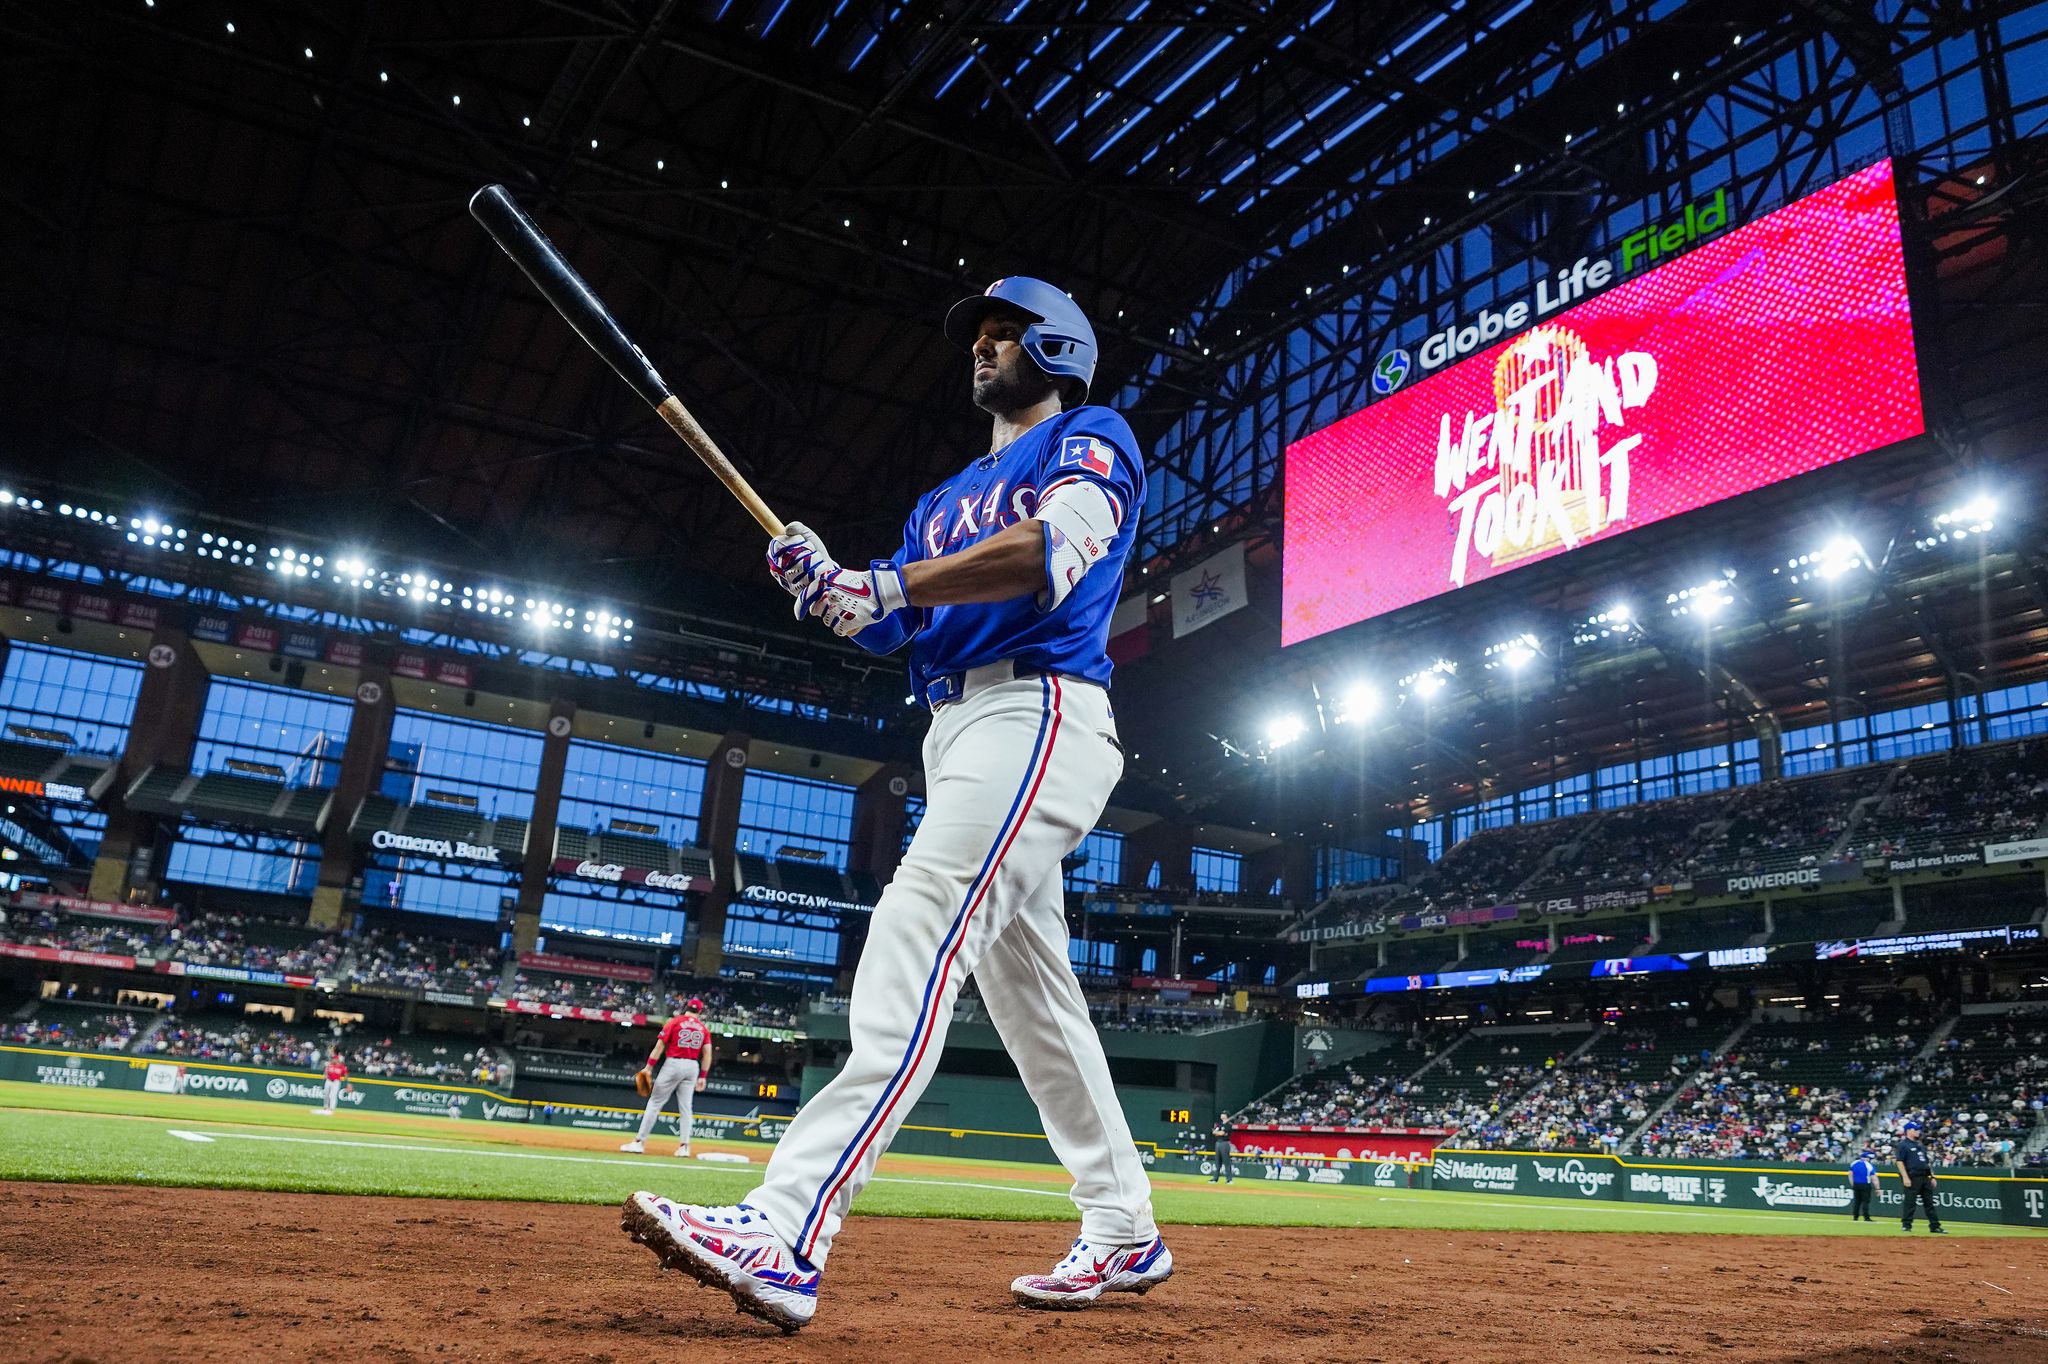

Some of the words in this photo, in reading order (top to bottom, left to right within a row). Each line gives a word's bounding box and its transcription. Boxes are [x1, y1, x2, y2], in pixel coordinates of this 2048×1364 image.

[1419, 301, 1529, 370] Globe
[1537, 257, 1612, 316] Life
[1622, 188, 1726, 273] Field
[1434, 368, 1559, 499] WENT
[1551, 350, 1658, 446] AND
[926, 479, 1036, 559] EXAS
[1448, 459, 1579, 588] TOOK
[1580, 433, 1642, 536] IT
[1083, 536, 1098, 557] 510
[455, 841, 499, 862] Bank
[1890, 855, 1915, 871] Real
[1917, 854, 1942, 868] fans
[1944, 852, 1980, 866] know.
[1727, 868, 1822, 892] POWERADE
[753, 886, 829, 909] CHOCTAW
[1547, 898, 1578, 911] PGL
[1420, 914, 1447, 928] 105.3
[1301, 928, 1321, 942] UT
[1323, 921, 1386, 940] DALLAS
[2012, 928, 2039, 939] 7:46
[1708, 946, 1768, 967] RANGERS
[678, 1029, 704, 1049] 29
[727, 1023, 794, 1041] STAFFING
[37, 1066, 105, 1081] ESTRELLA
[184, 1073, 249, 1093] TOYOTA
[288, 1083, 325, 1099] Medic
[1451, 1159, 1518, 1181] National
[1558, 1159, 1615, 1196] Kroger
[1473, 1180, 1487, 1189] Car
[1488, 1181, 1514, 1191] Rental
[1662, 1176, 1703, 1194] BITE
[1780, 1182, 1854, 1200] Germania
